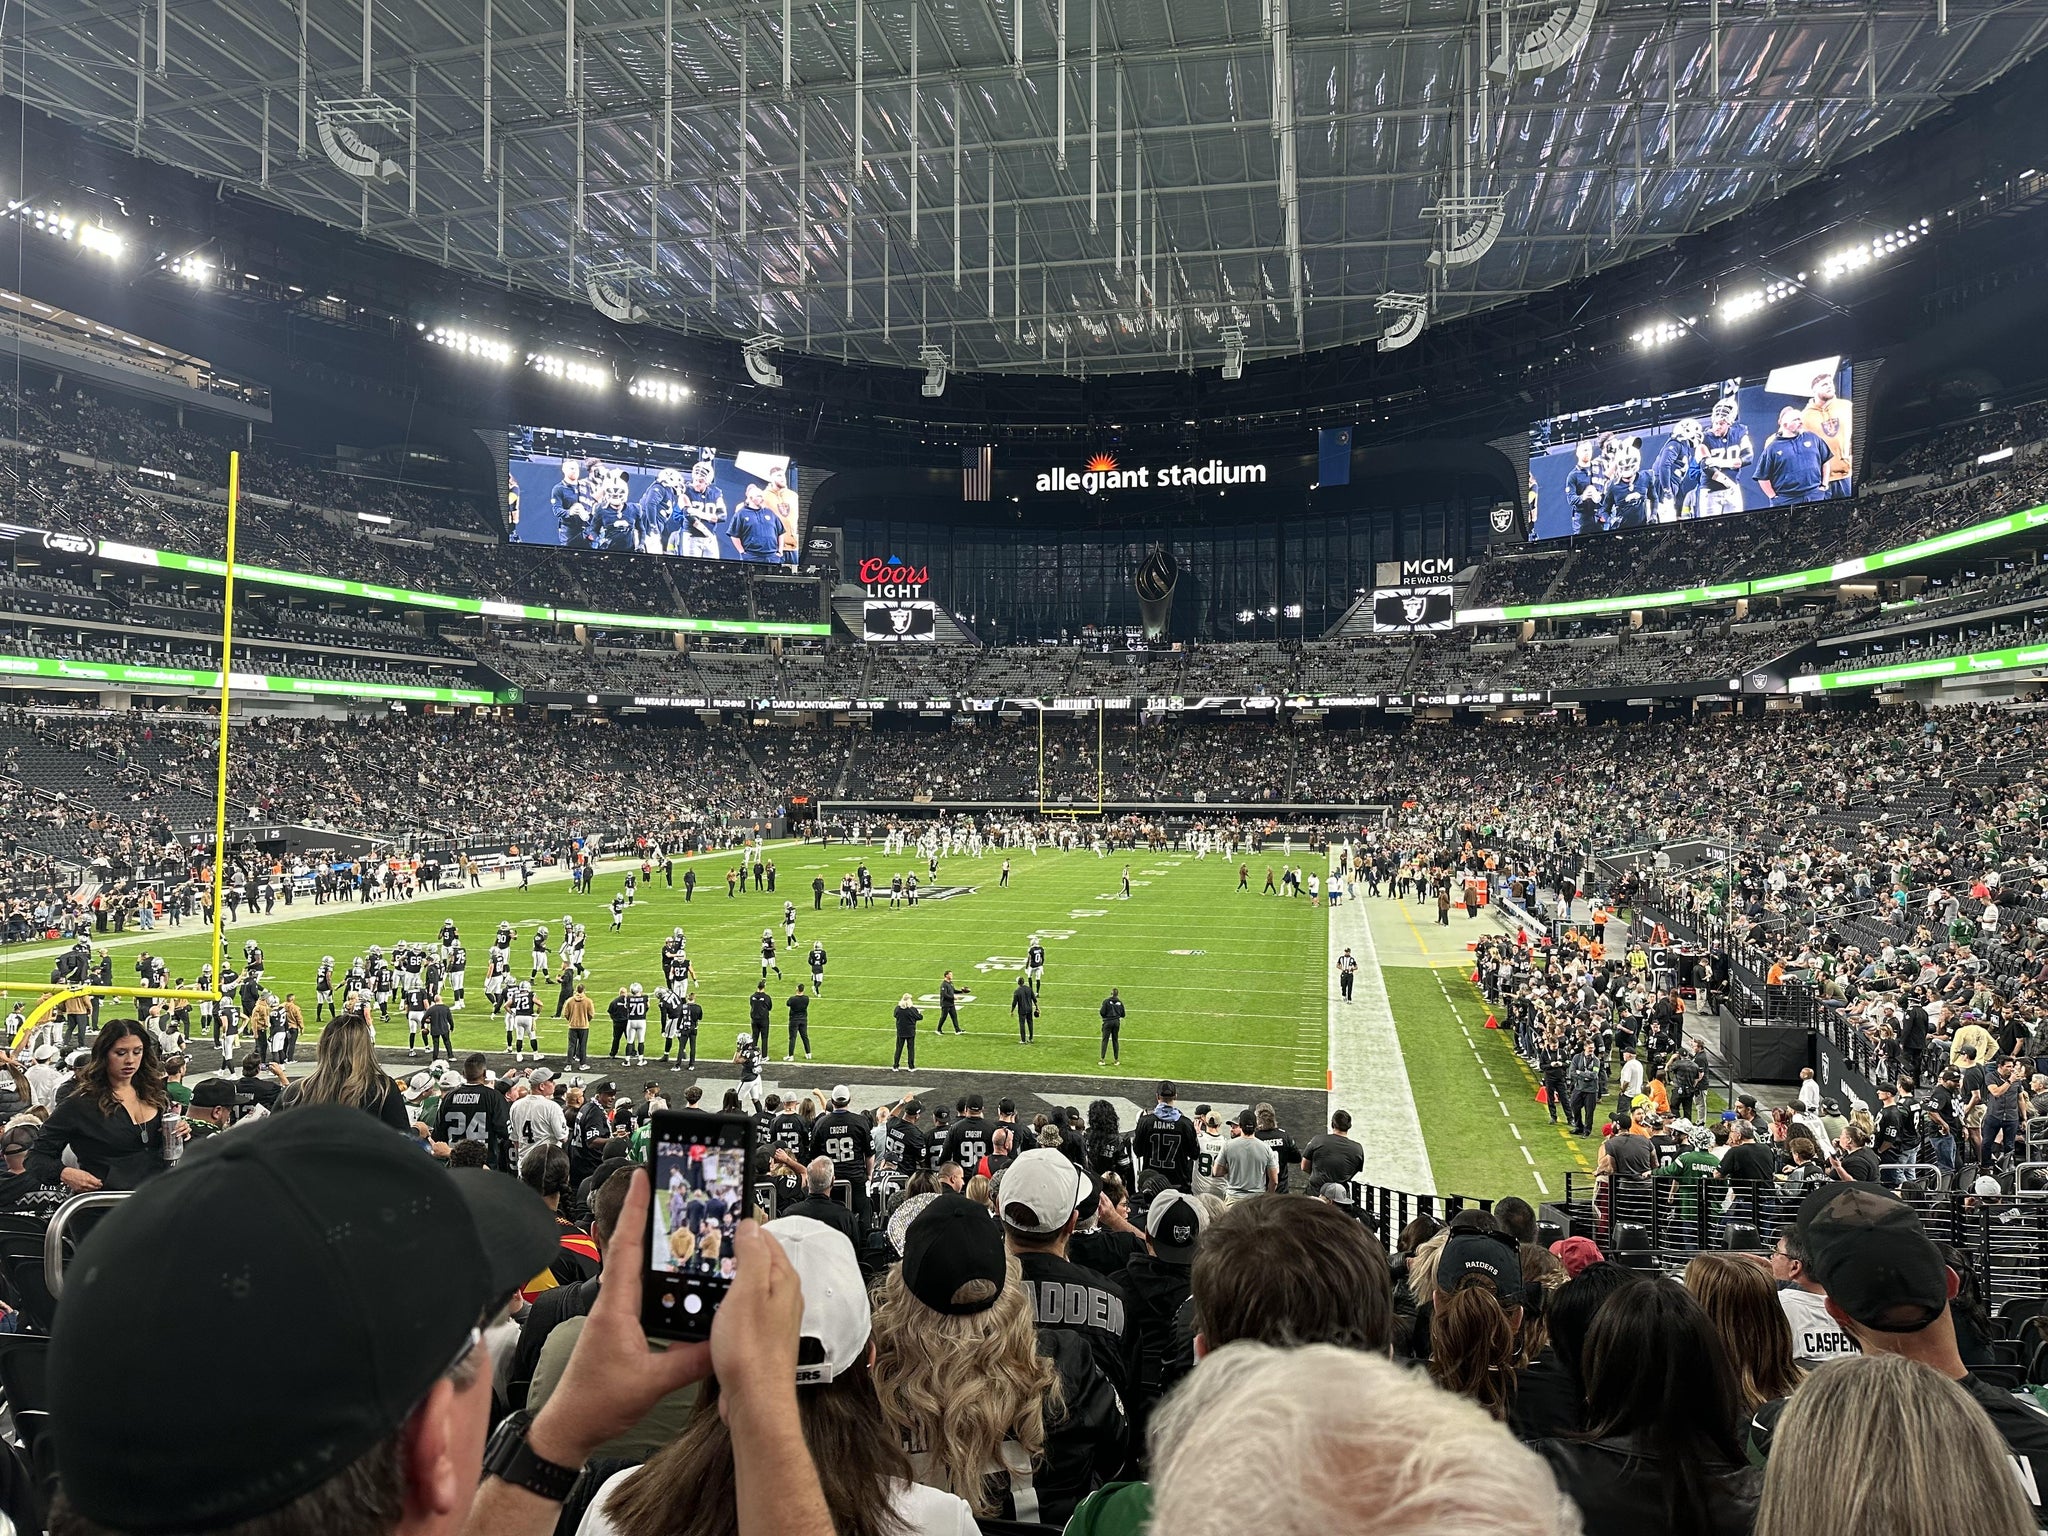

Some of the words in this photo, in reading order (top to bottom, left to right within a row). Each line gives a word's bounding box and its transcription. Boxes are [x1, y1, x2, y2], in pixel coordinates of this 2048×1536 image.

[1036, 466, 1149, 495] allegiant
[1157, 459, 1267, 487] stadium
[859, 557, 930, 584] Coors
[1404, 558, 1454, 575] MGM
[1404, 575, 1454, 585] REWARDS
[867, 584, 922, 598] LIGHT
[635, 697, 670, 706] FANTASY
[671, 698, 706, 708] LEADERS
[1319, 698, 1377, 706] SCOREBOARD
[1388, 697, 1403, 705] NFL
[1429, 696, 1445, 704] DEN
[1473, 695, 1488, 703] BUF
[1528, 693, 1540, 701] PM
[713, 699, 746, 708] RUSHING
[772, 700, 796, 709] DAVID
[796, 700, 851, 710] MONTGOMERY
[271, 830, 280, 839] 25
[411, 956, 422, 965] 68
[1653, 952, 1666, 966] C
[410, 993, 418, 1006] 4
[515, 997, 529, 1010] 72
[629, 1002, 645, 1016] 70
[232, 1012, 239, 1027] 6
[452, 1093, 481, 1105] WOODSON
[444, 1111, 489, 1148] 24
[829, 1125, 848, 1135] CROSBY
[1153, 1120, 1175, 1130] ADAMS
[522, 1120, 534, 1144] 4
[586, 1129, 600, 1141] 98
[965, 1130, 983, 1138] CROSBY
[1885, 1127, 1897, 1138] 98
[825, 1136, 854, 1162] 98
[1150, 1133, 1182, 1170] 17
[1465, 1260, 1499, 1276] RAIDERS
[1020, 1280, 1125, 1337] ADDEN
